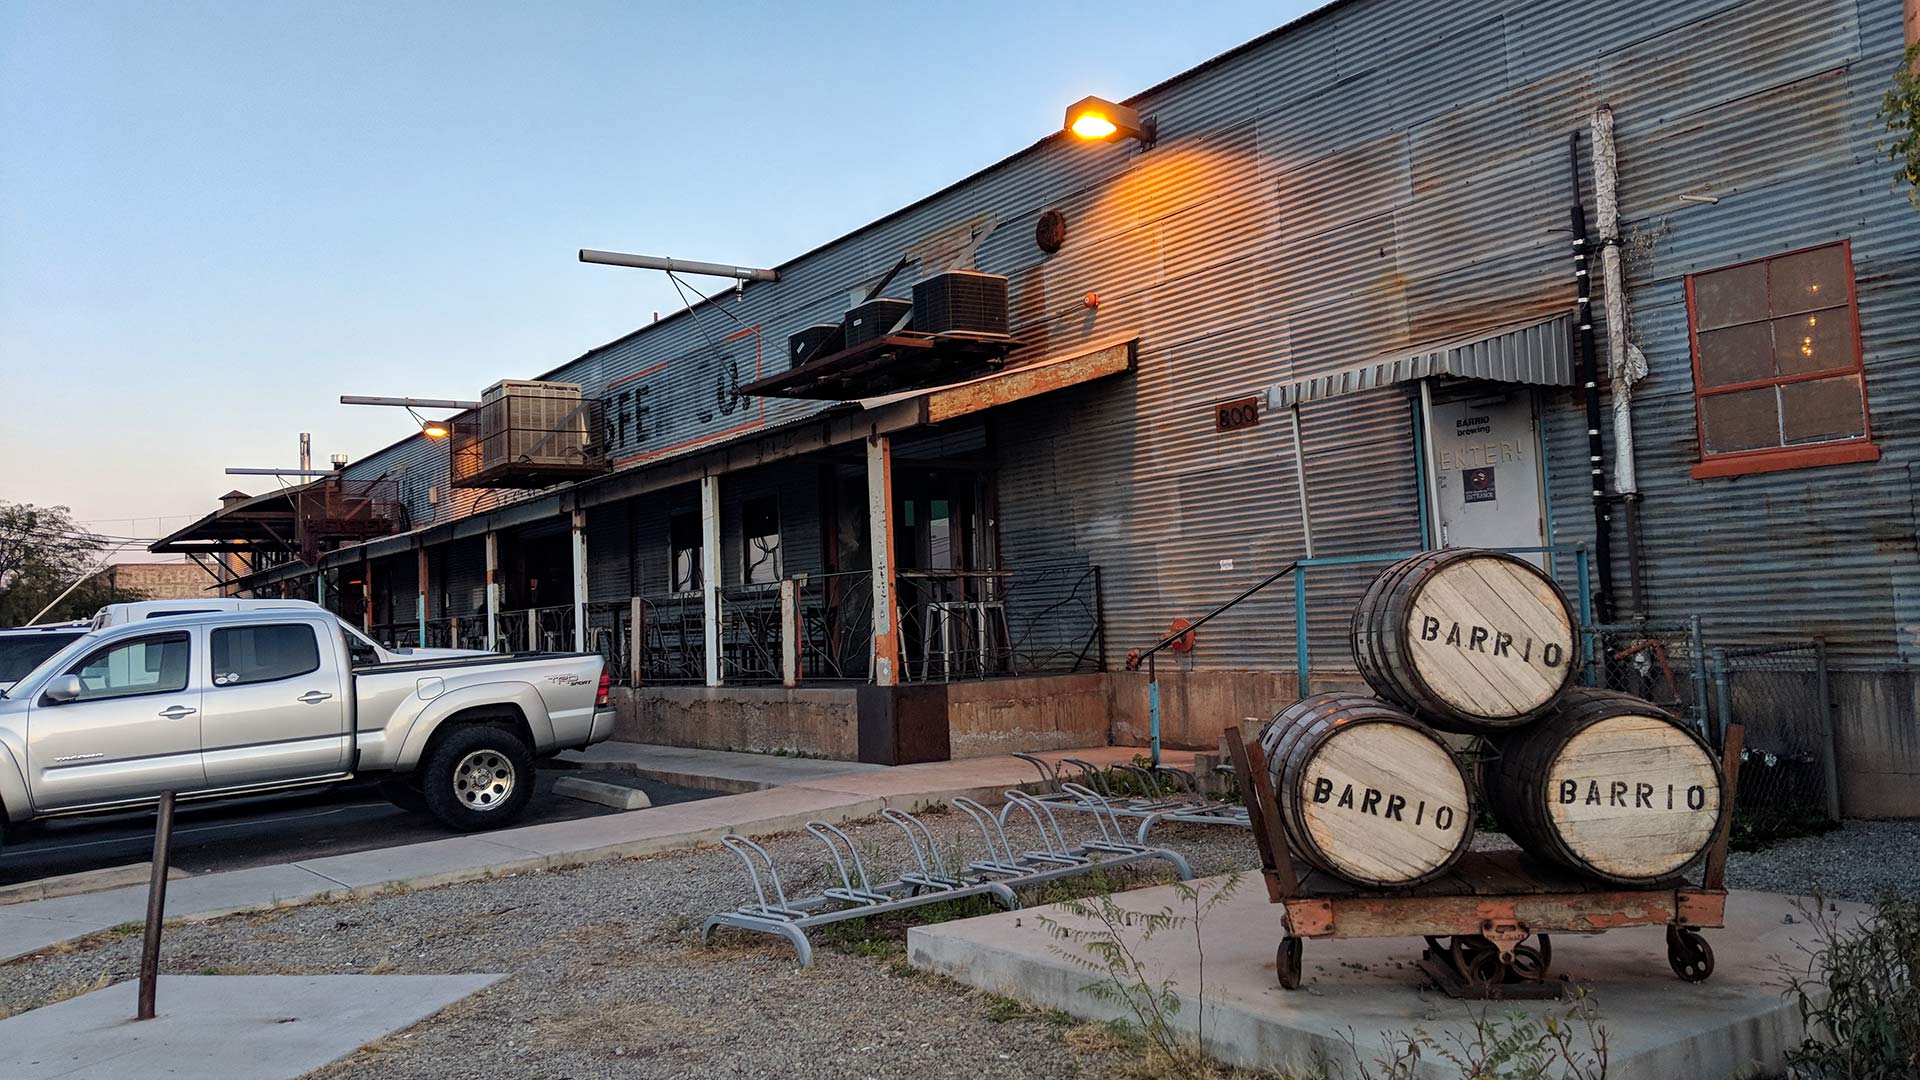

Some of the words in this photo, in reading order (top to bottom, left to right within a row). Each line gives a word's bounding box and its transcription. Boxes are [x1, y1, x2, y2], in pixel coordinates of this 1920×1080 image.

[1220, 404, 1254, 427] 800
[1456, 416, 1490, 428] BARRIO
[1457, 425, 1491, 437] brewing
[1439, 440, 1522, 470] ENTER!
[1421, 615, 1563, 668] BARRIO
[1313, 777, 1454, 831] BARRIO
[1559, 779, 1705, 811] BARRIO
